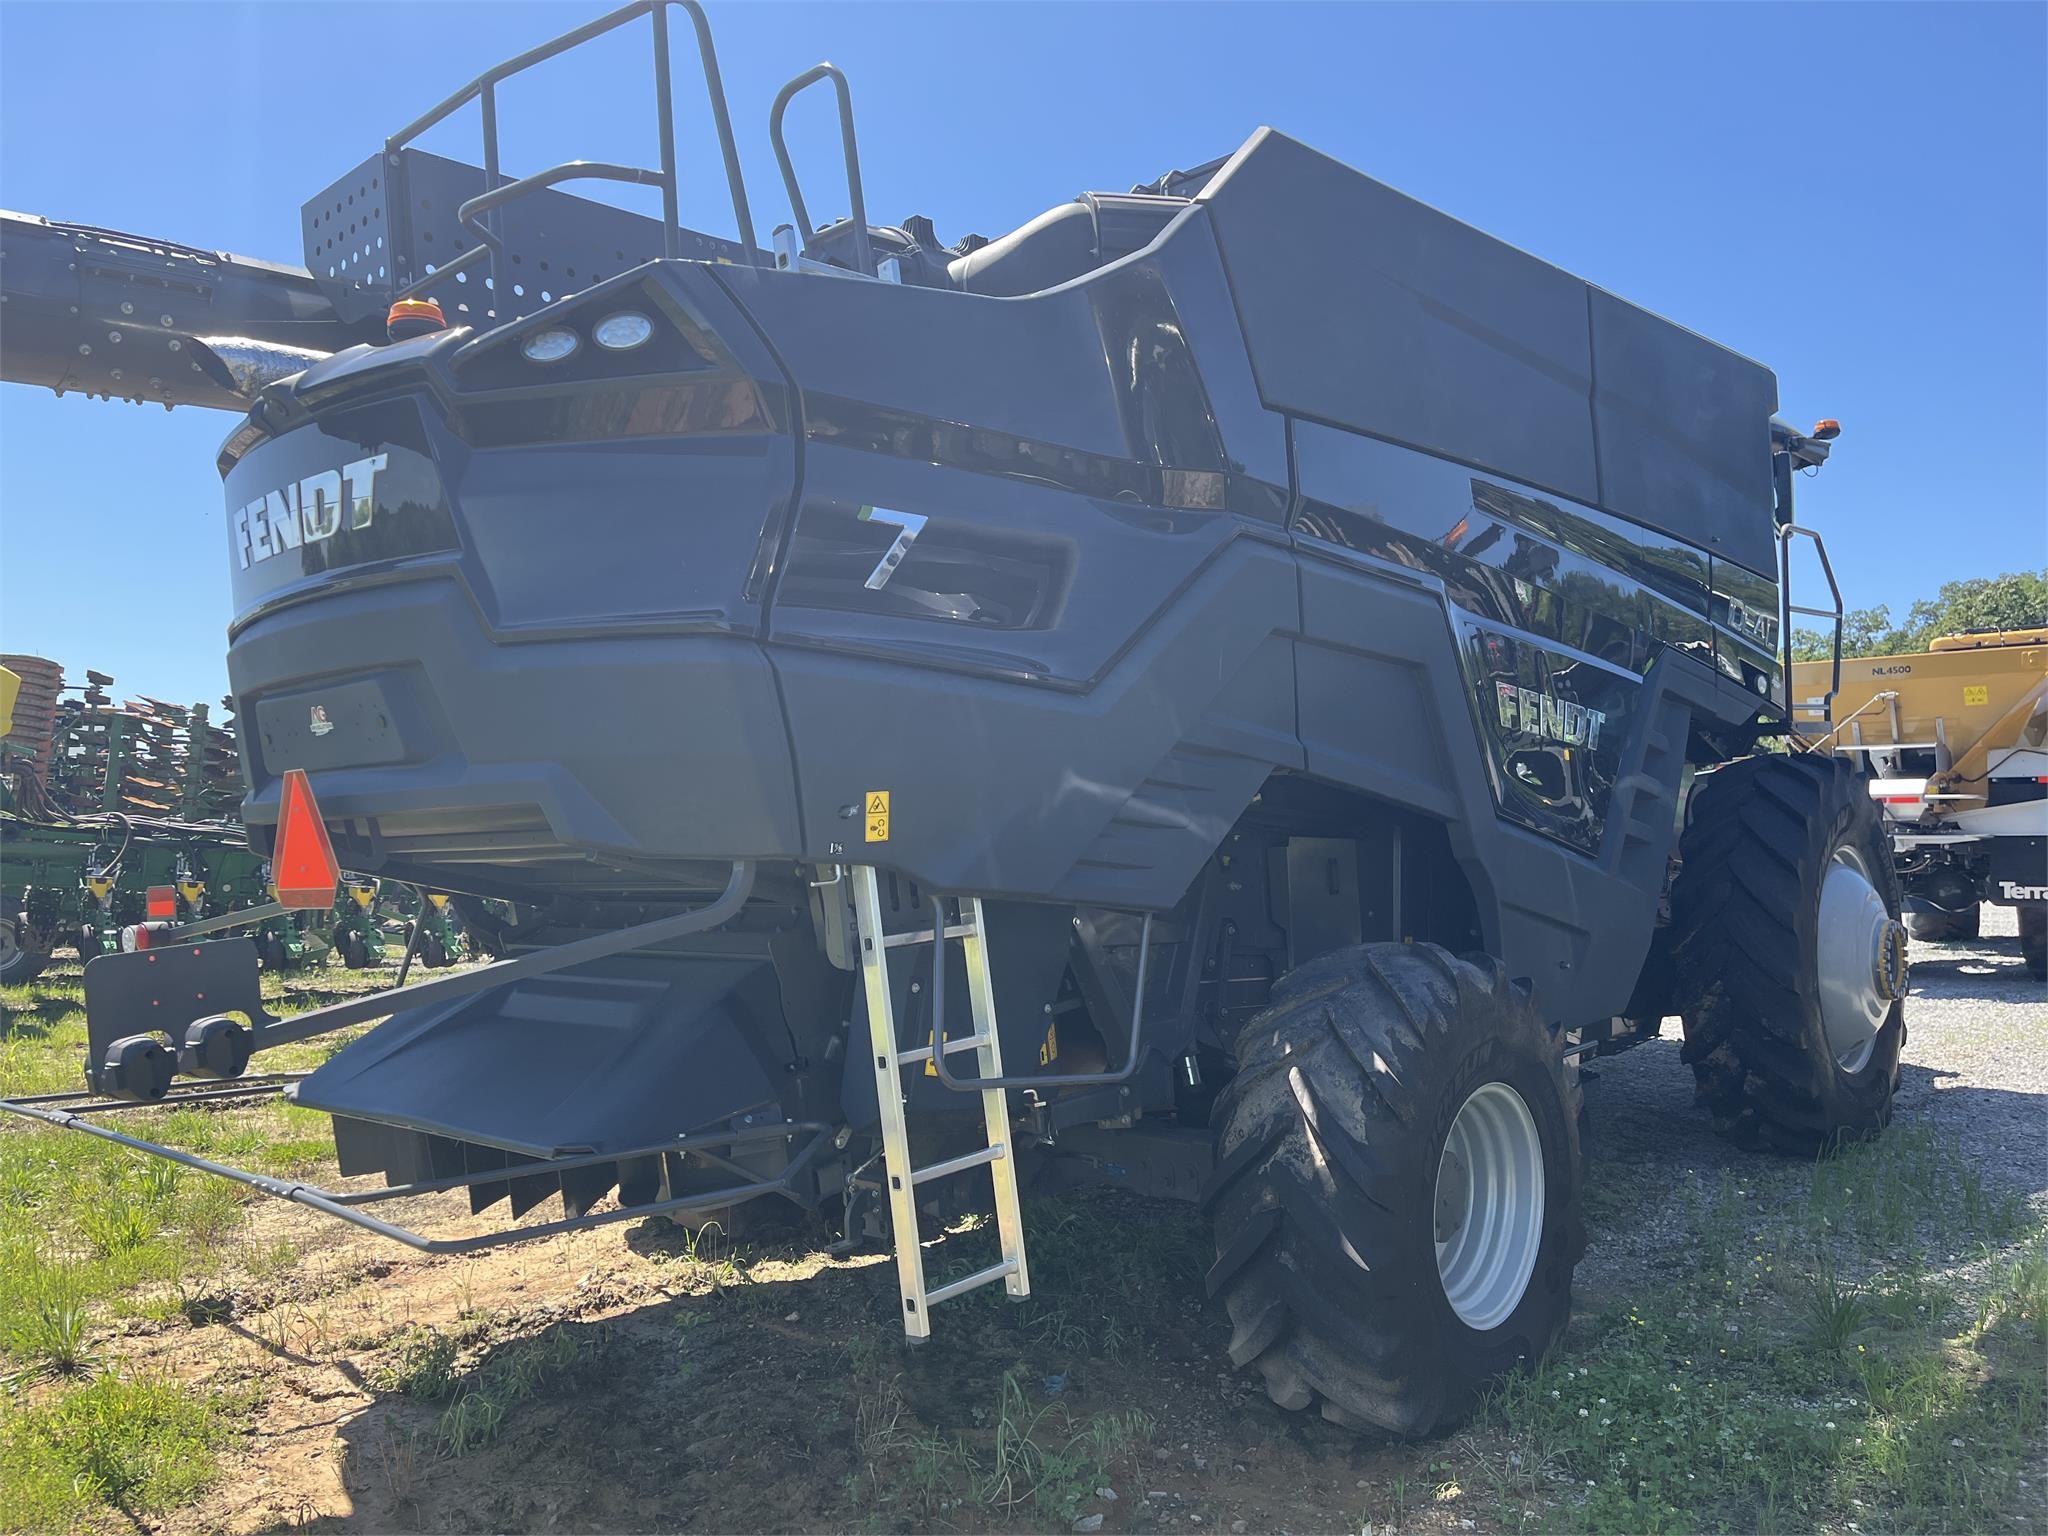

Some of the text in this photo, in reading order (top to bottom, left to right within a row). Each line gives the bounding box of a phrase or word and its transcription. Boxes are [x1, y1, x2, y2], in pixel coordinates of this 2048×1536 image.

[233, 453, 388, 571] FENDT
[857, 505, 928, 589] 7
[1872, 665, 1911, 676] NL4500
[1496, 681, 1606, 751] FENDT
